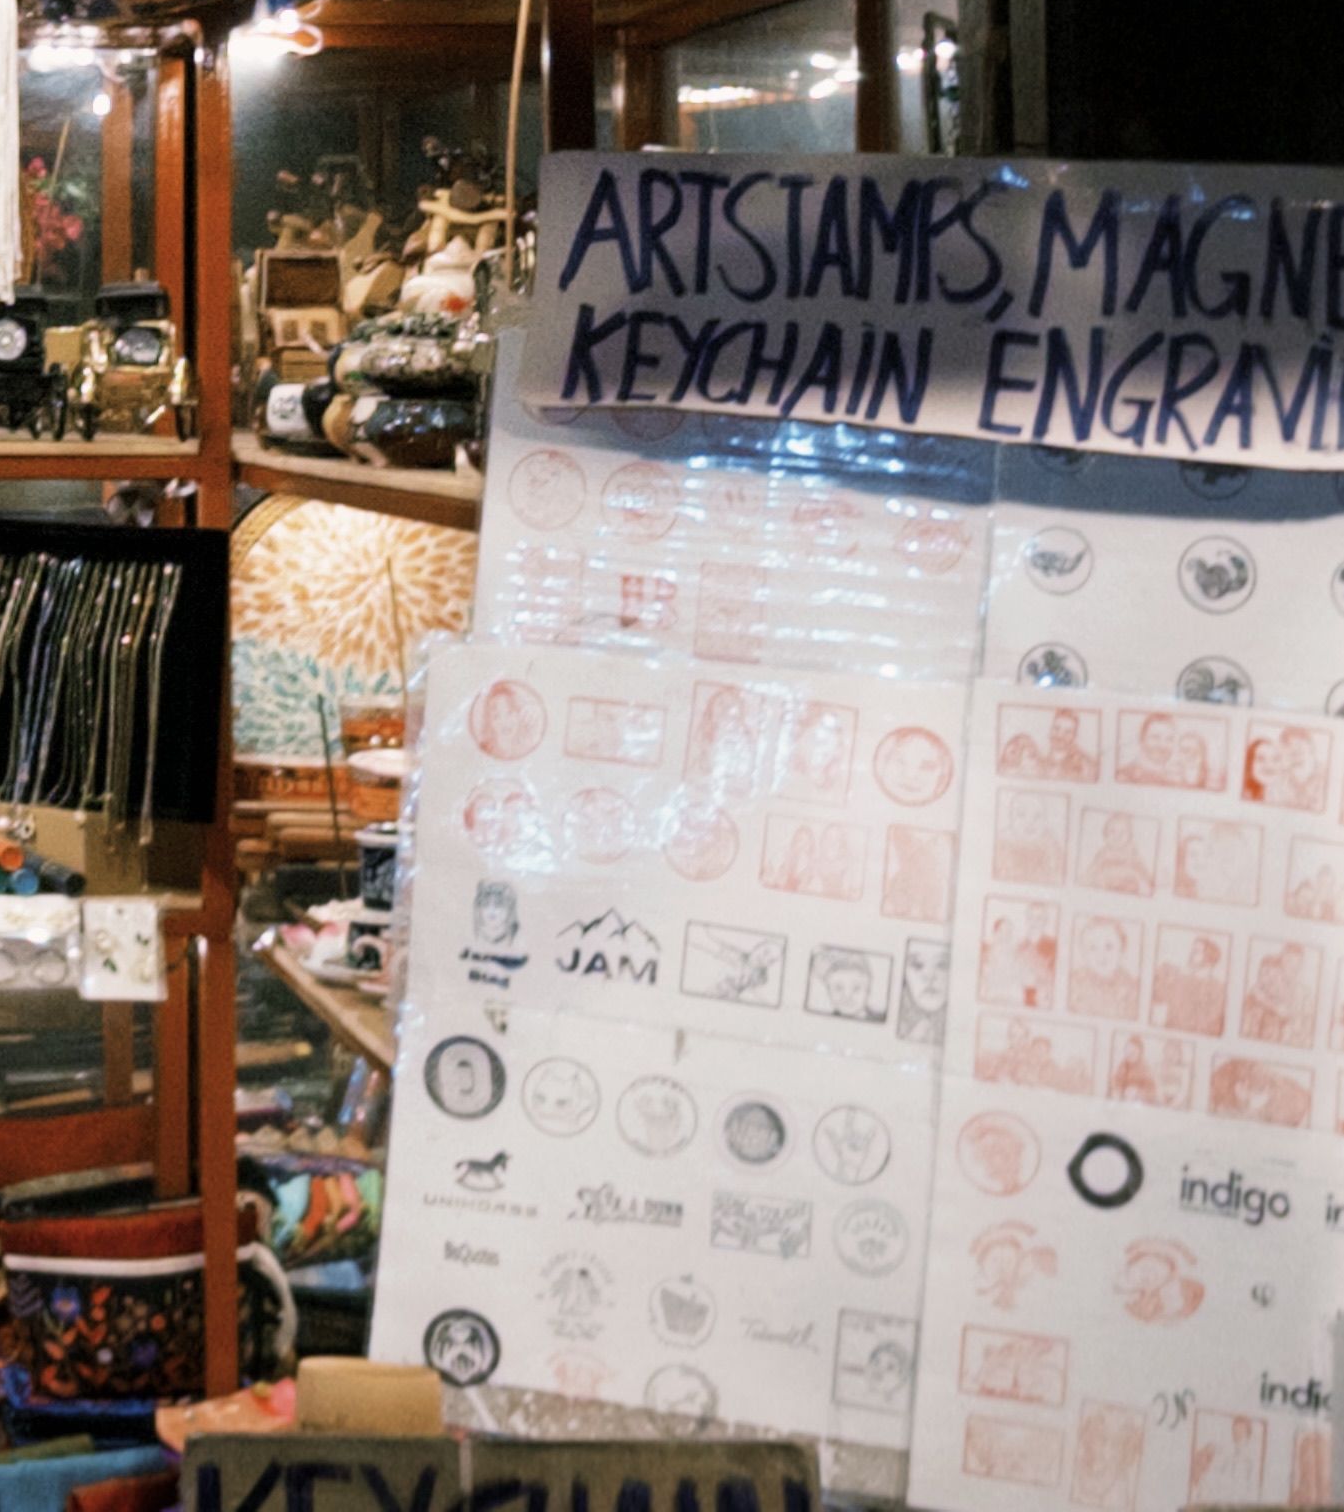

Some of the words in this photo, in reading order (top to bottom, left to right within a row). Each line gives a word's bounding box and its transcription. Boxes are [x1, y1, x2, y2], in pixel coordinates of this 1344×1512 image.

[561, 302, 933, 426] KEYCHAIN
[556, 948, 660, 986] JAM
[1179, 1164, 1291, 1226] indigo
